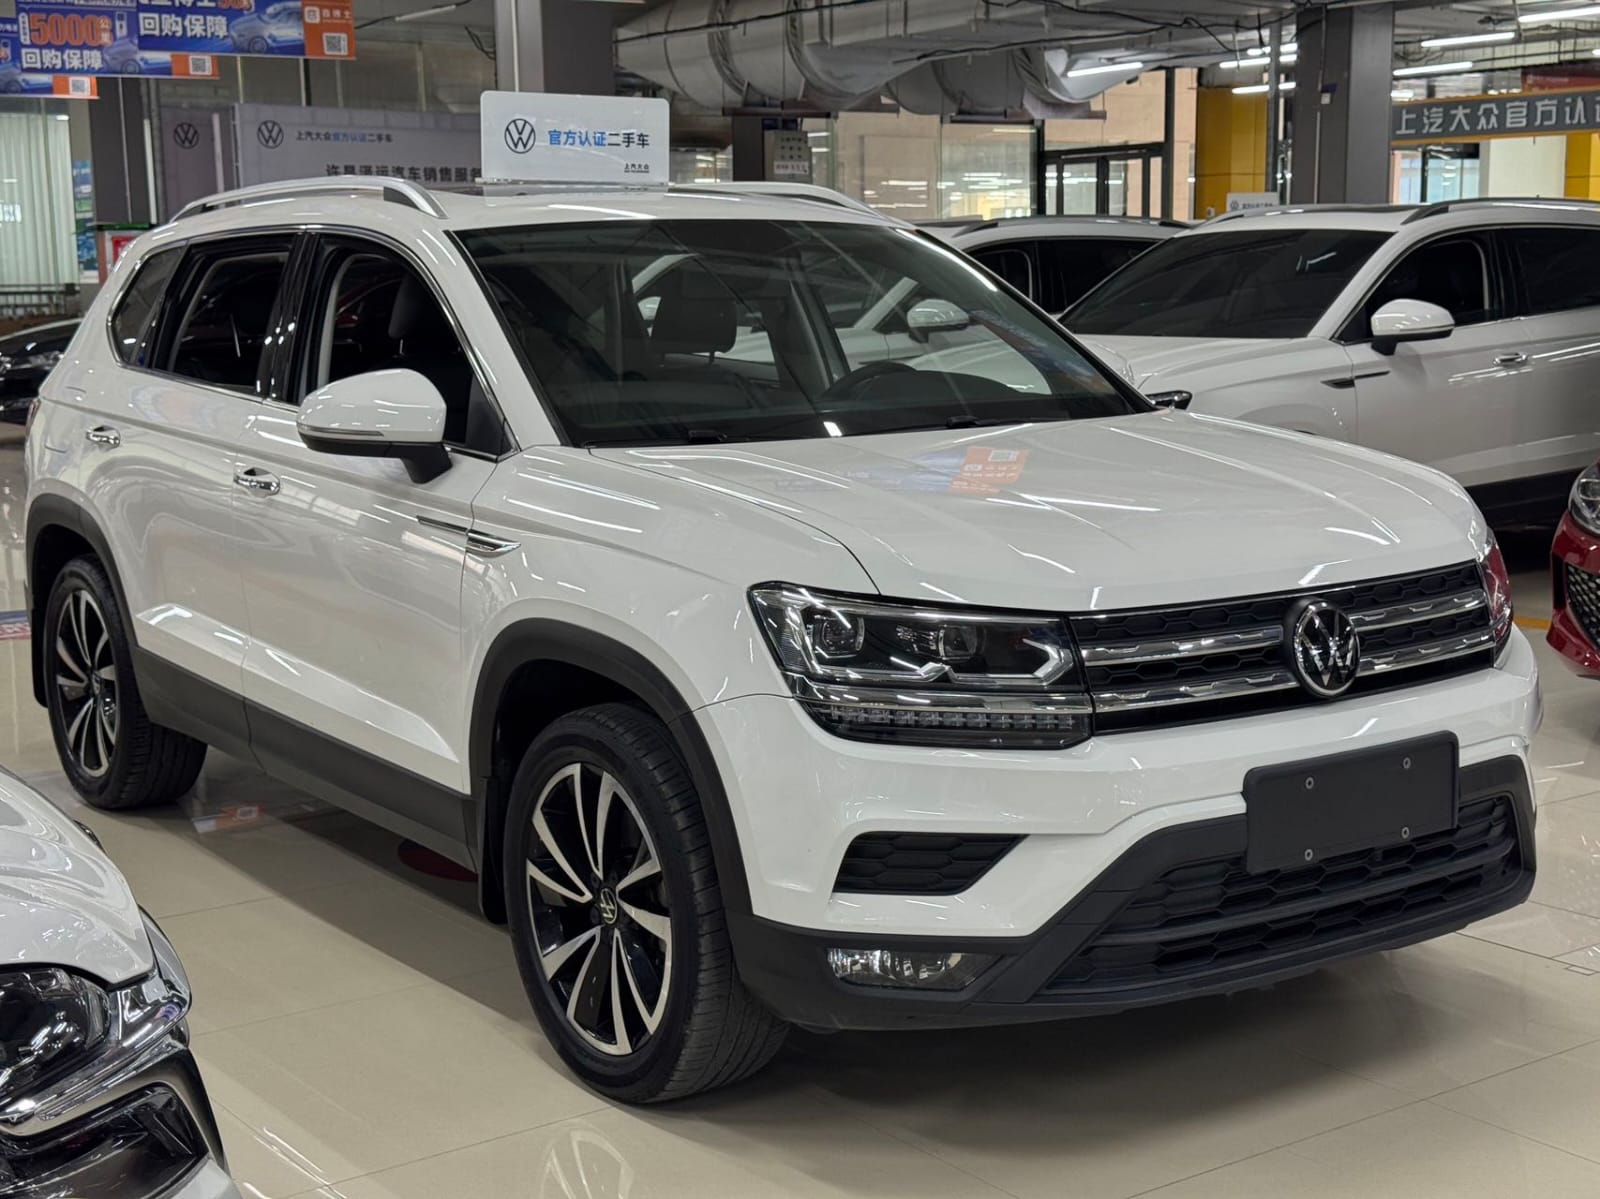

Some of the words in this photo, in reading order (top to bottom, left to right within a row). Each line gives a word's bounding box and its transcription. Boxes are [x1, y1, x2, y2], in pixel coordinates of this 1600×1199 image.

[29, 12, 101, 47] 5000
[138, 12, 228, 39] 回购保障
[21, 48, 103, 70] 回购保障
[548, 129, 650, 149] 官方认证二手车
